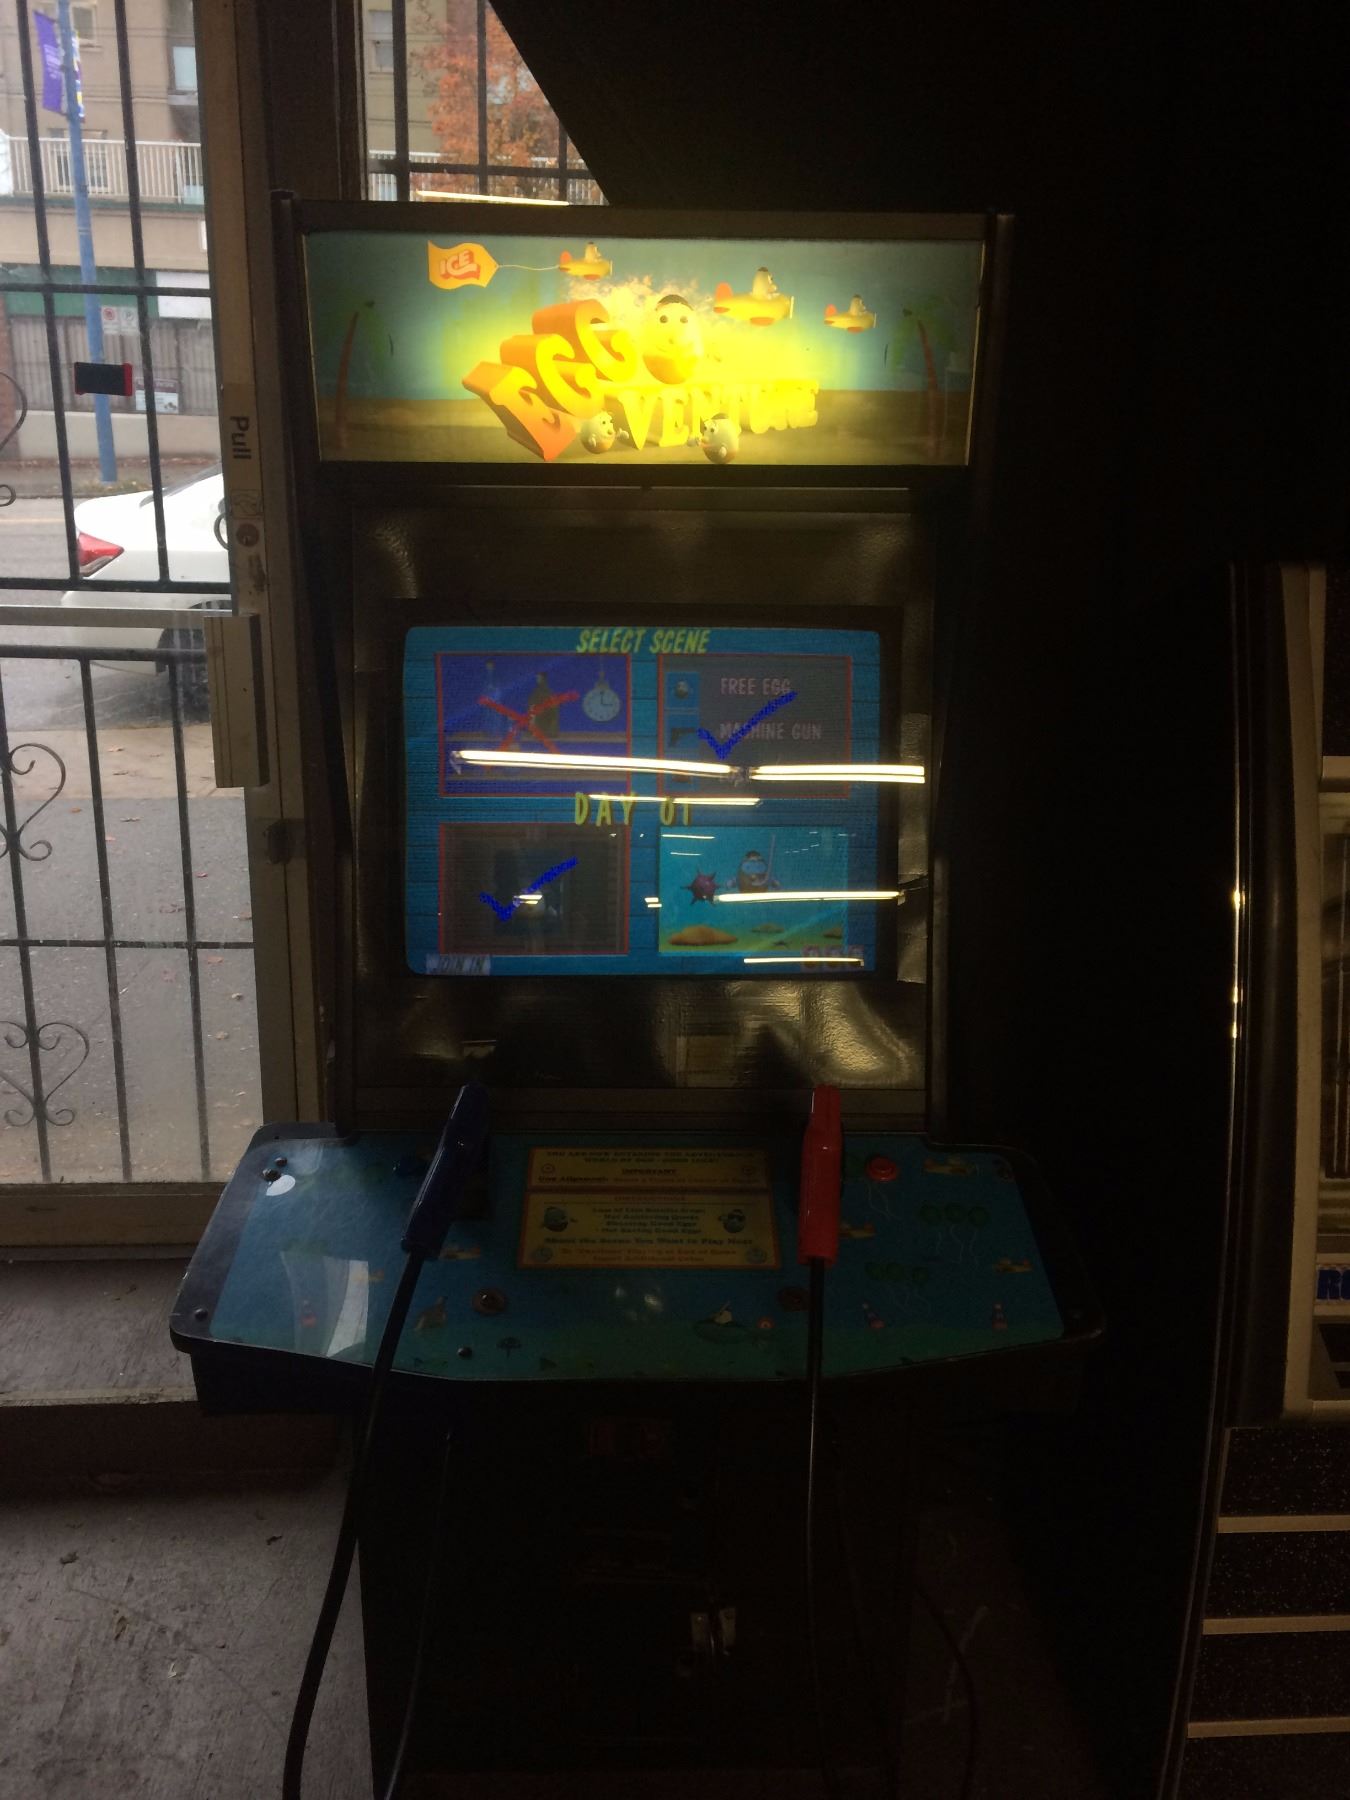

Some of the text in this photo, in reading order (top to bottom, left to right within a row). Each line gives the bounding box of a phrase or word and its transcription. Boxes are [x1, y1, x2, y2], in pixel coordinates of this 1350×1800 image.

[440, 249, 480, 280] ICE
[462, 299, 639, 462] EGG
[229, 416, 252, 460] Pull
[576, 628, 711, 654] SELECT SCENE
[720, 677, 756, 696] FREE
[791, 723, 822, 741] GUN
[574, 791, 637, 827] DAY
